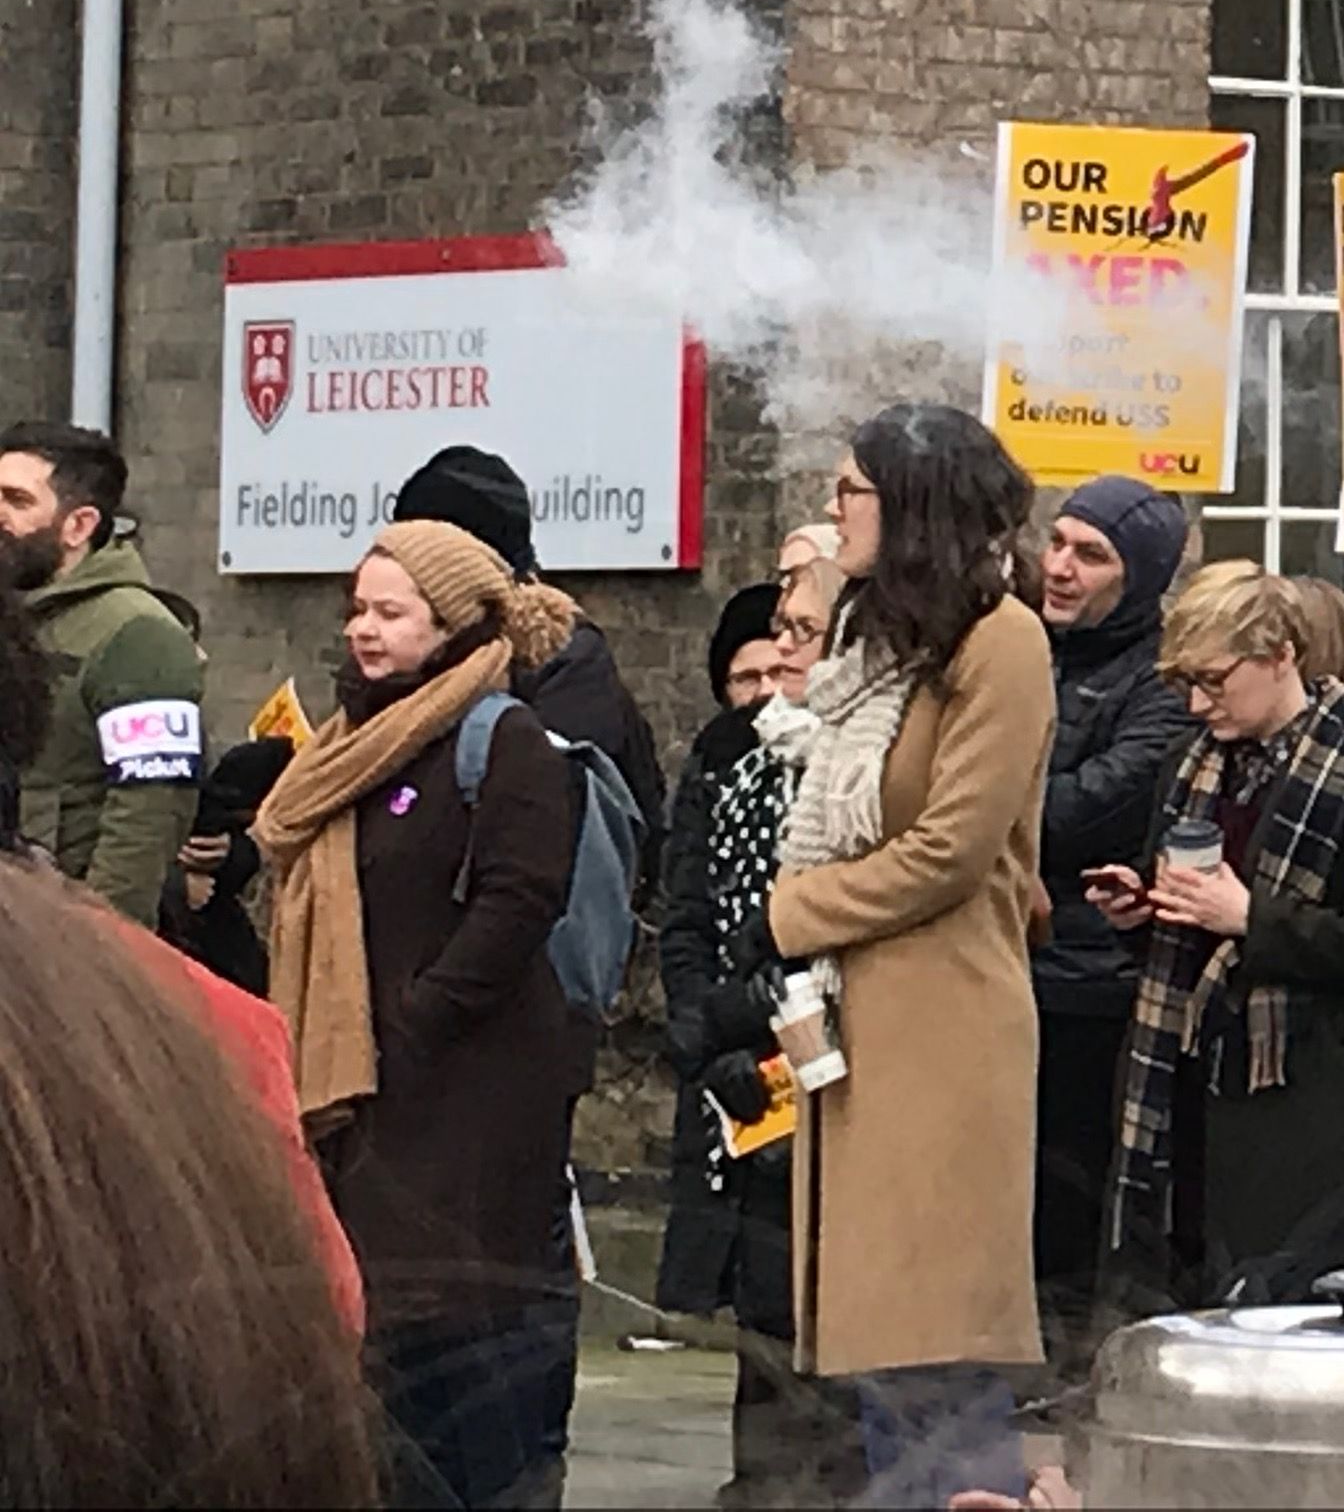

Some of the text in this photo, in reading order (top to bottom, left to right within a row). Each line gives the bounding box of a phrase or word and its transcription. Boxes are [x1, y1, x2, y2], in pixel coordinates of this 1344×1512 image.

[1022, 158, 1107, 194] OUR
[1020, 201, 1207, 244] PENSION
[307, 326, 490, 364] UNIVERSITY OF
[306, 366, 492, 413] LEICESTER
[1153, 369, 1182, 393] to
[1008, 398, 1107, 427] defend
[236, 482, 358, 539] Fielding
[533, 475, 646, 534] uilding
